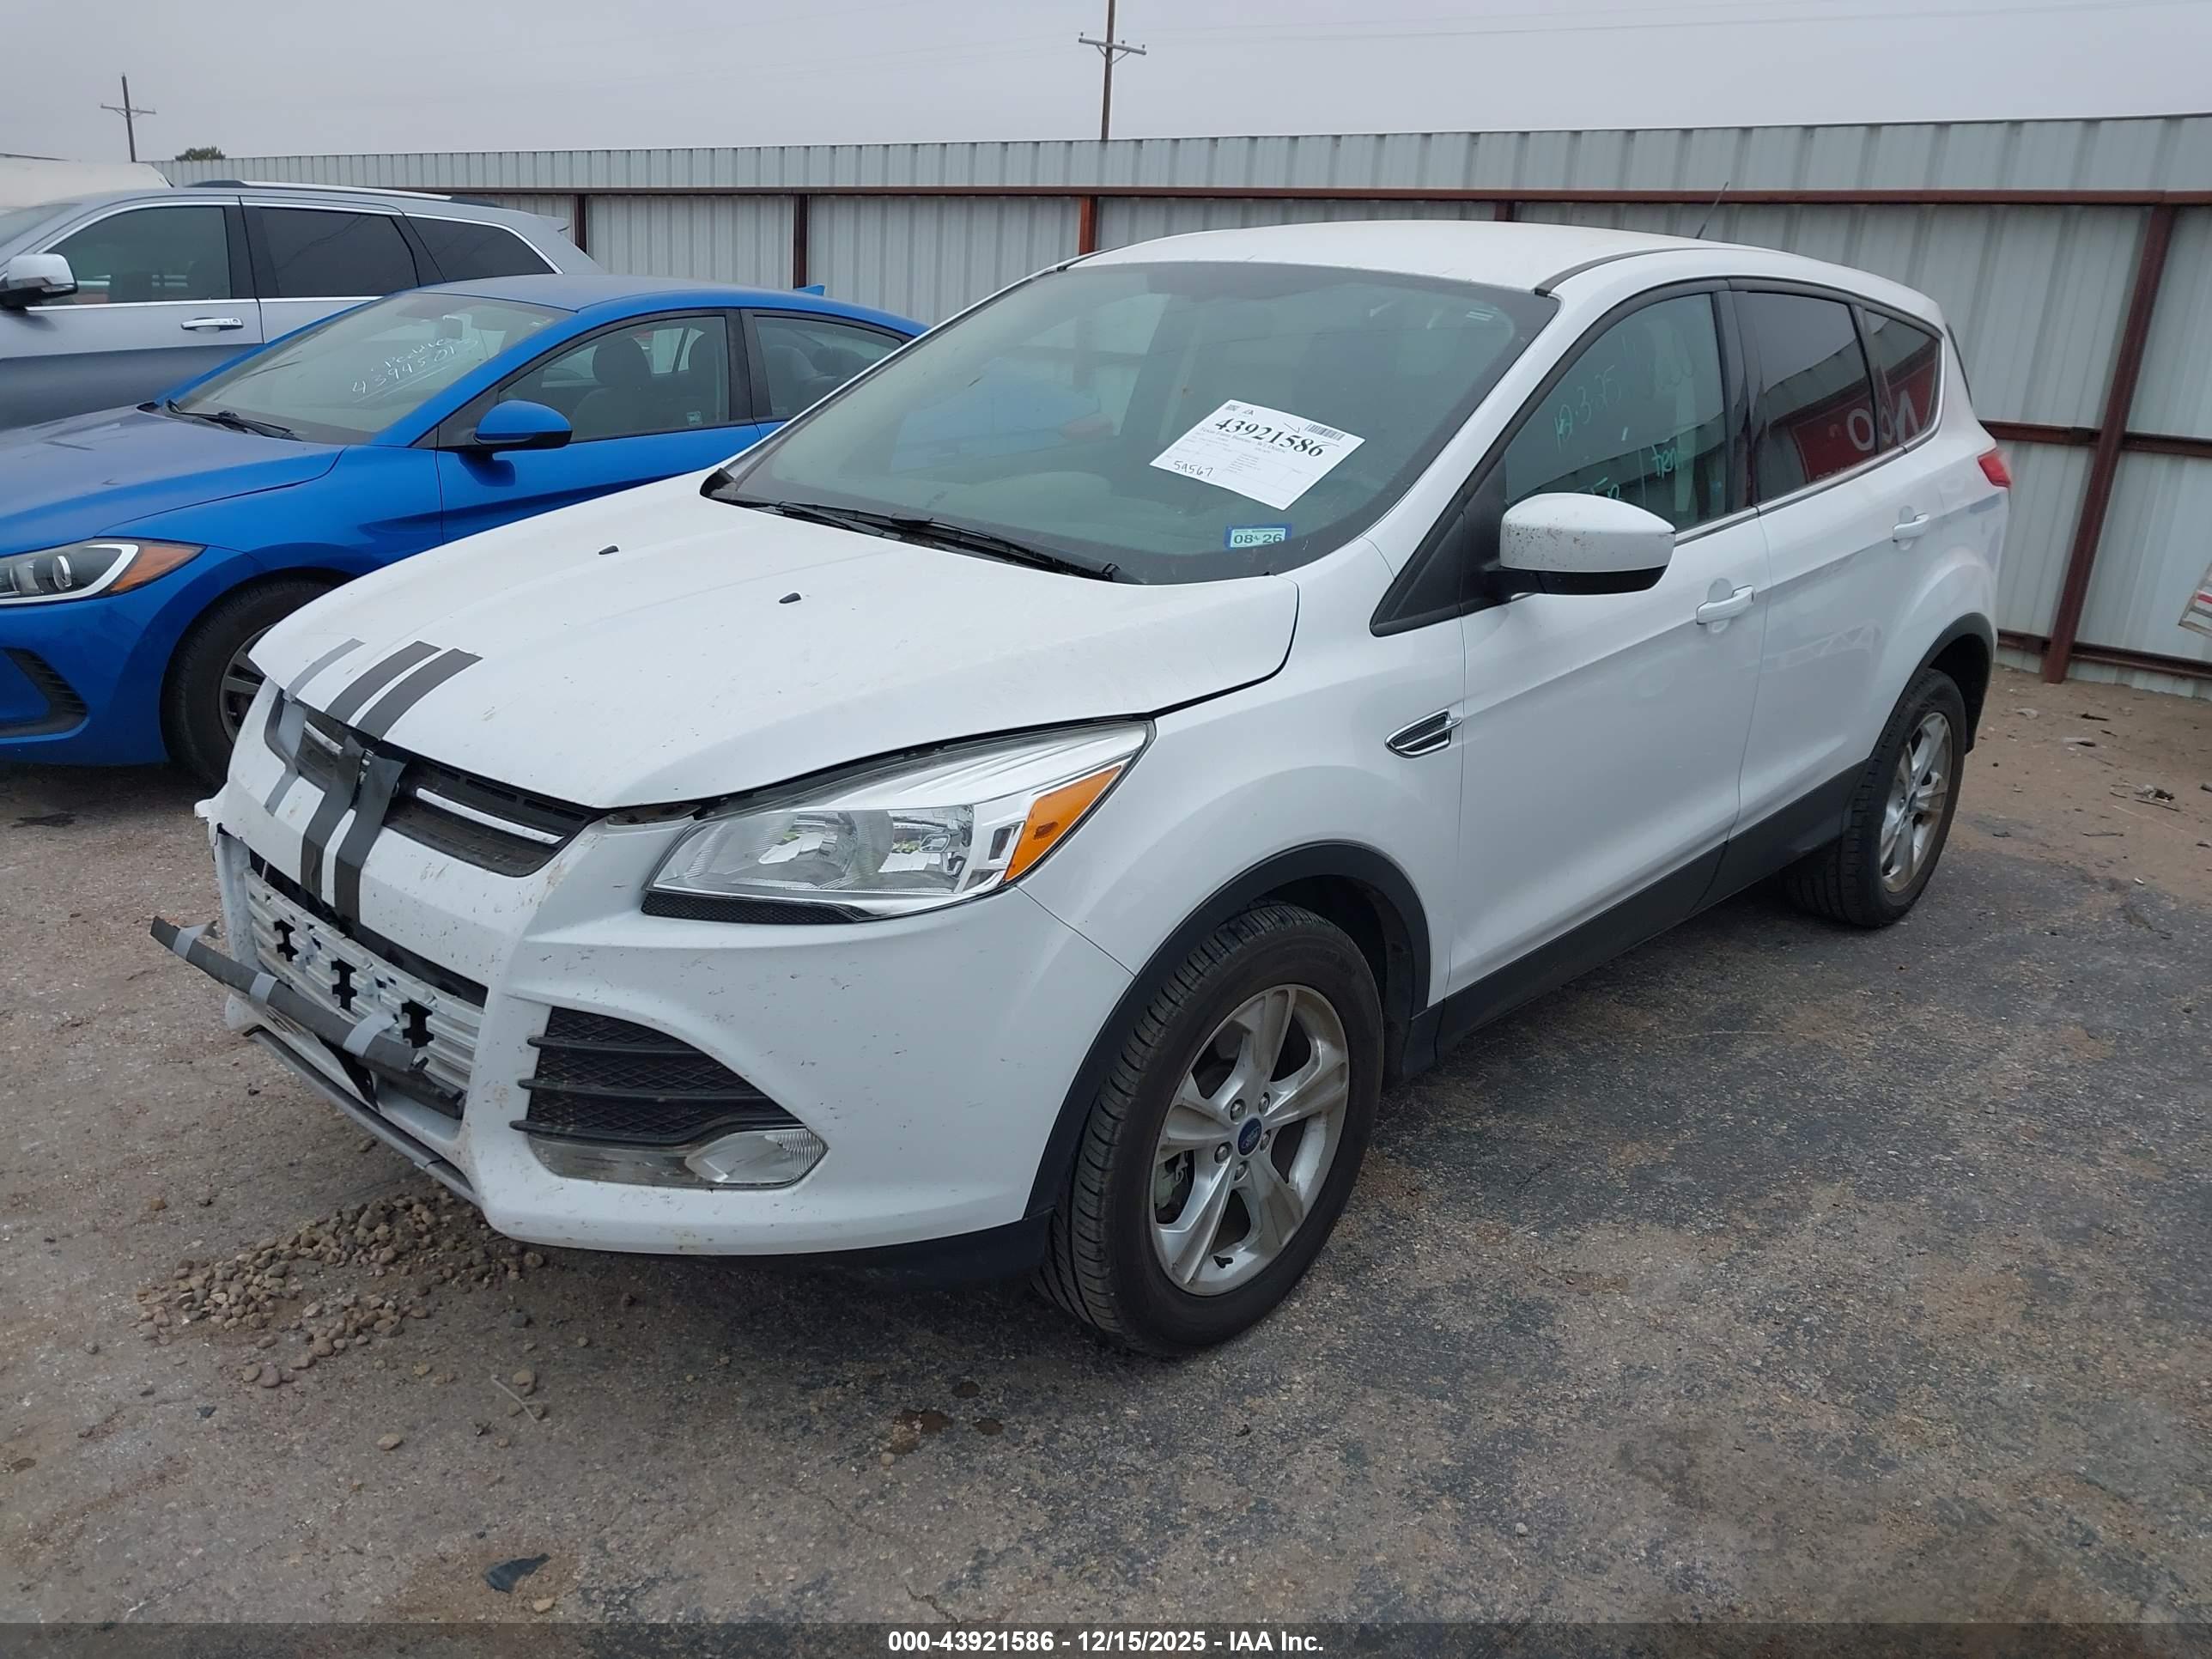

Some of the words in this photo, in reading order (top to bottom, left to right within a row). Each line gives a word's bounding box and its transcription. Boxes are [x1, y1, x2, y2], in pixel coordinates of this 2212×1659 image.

[1214, 417, 1324, 459] 43921586
[1234, 534, 1254, 544] 08
[1262, 533, 1283, 544] 26
